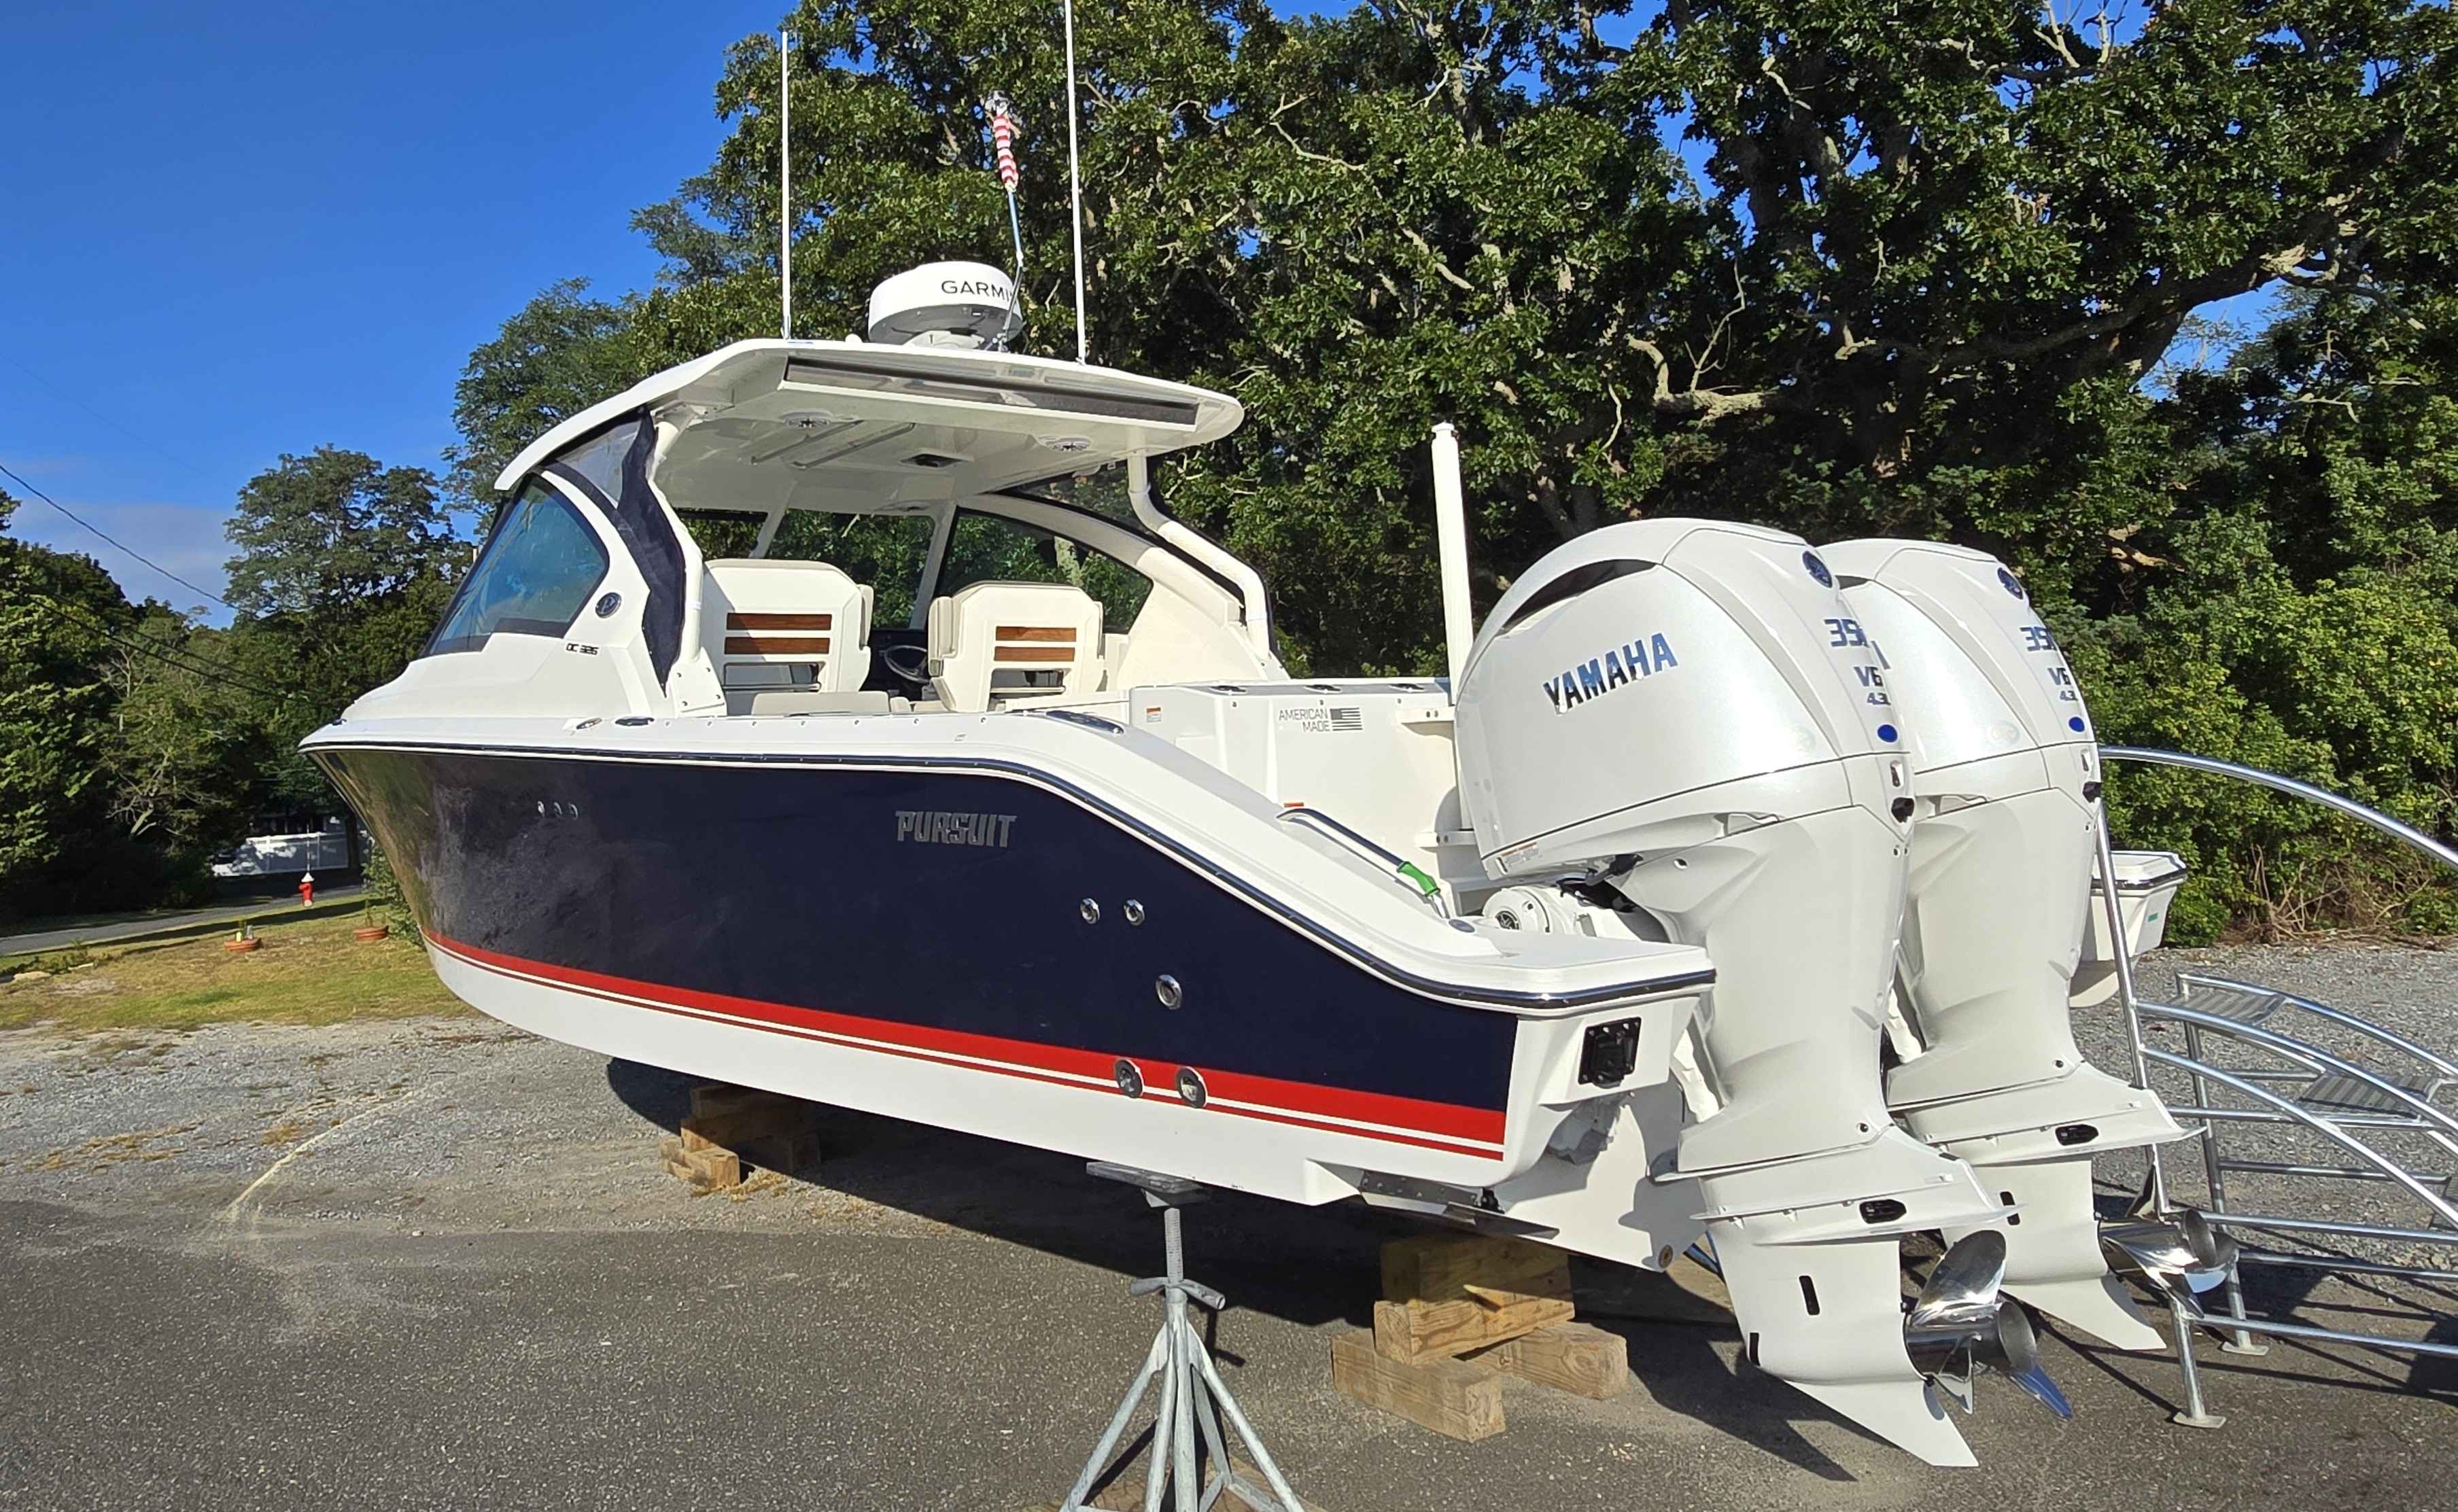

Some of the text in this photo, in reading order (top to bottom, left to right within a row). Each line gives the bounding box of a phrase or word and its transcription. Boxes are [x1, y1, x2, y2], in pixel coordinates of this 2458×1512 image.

[941, 280, 1012, 302] GARMI
[1542, 632, 1678, 715] YAMAHA
[1853, 666, 1884, 686] V6
[1279, 708, 1328, 721] AMERICAN
[1302, 720, 1330, 732] MADE
[895, 810, 1017, 847] PURSUIT
